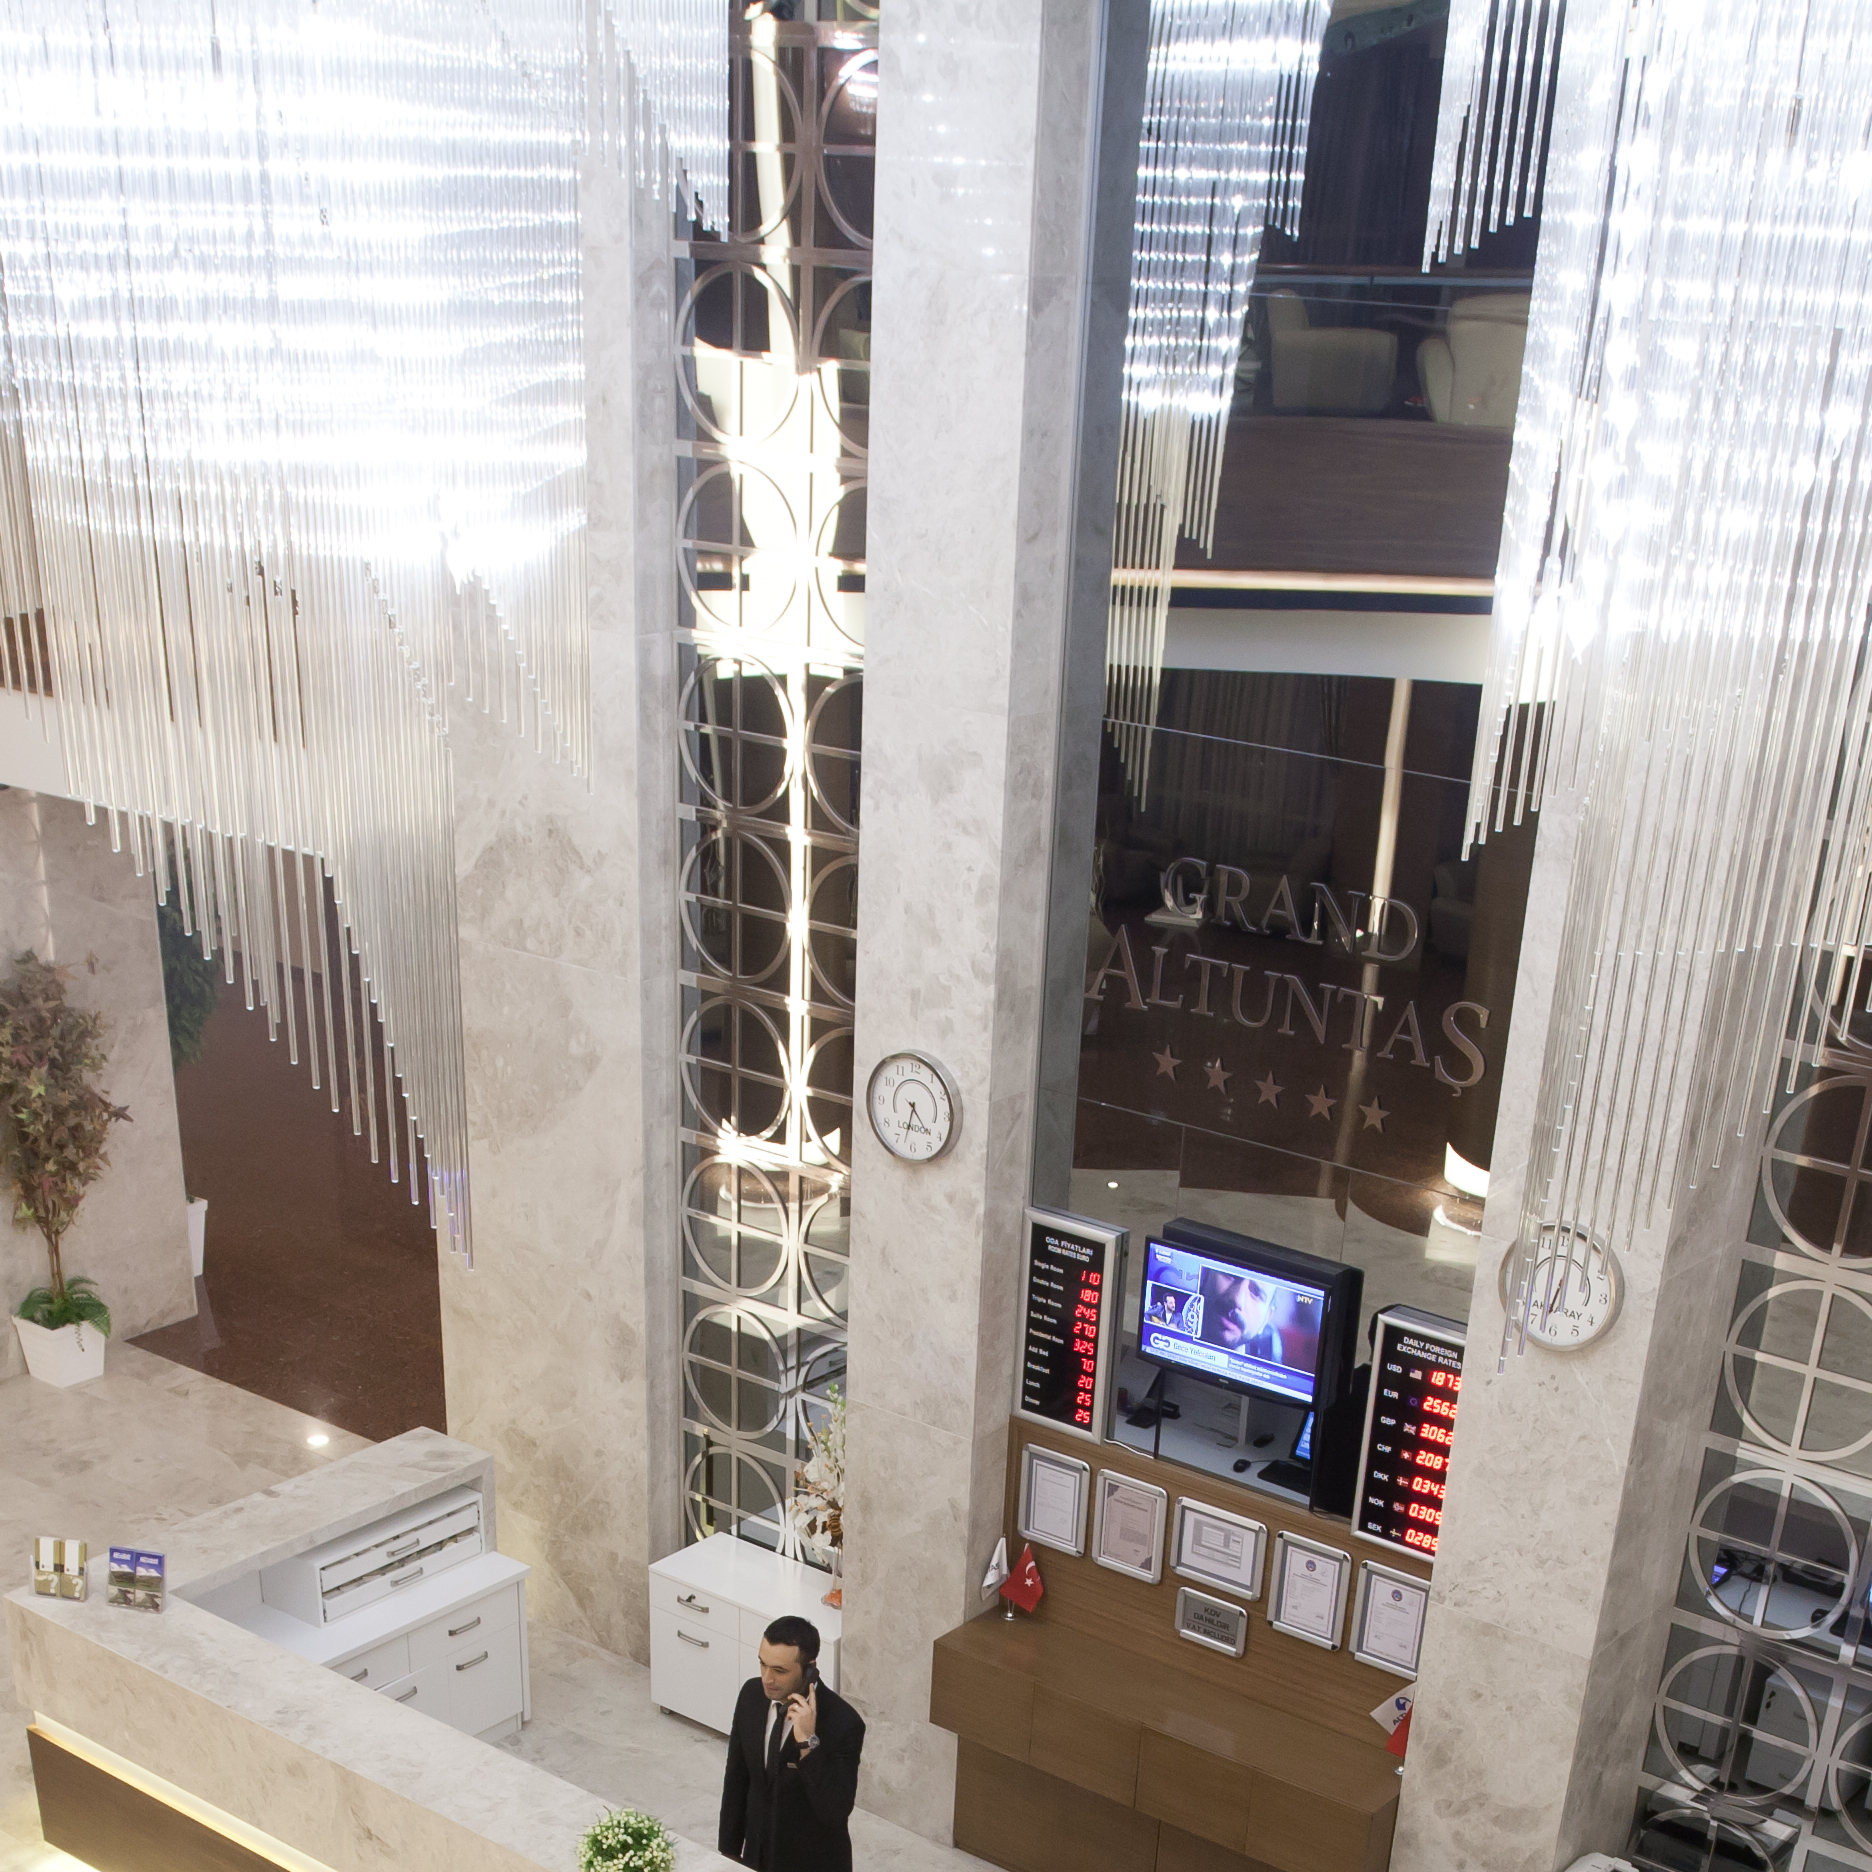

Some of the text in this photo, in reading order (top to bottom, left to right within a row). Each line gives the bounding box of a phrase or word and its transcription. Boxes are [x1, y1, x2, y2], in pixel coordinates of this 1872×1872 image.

[1160, 856, 1421, 963] GRAND
[1083, 923, 1493, 1098] ALTUNTAŞ
[896, 1064, 905, 1077] 11
[910, 1062, 921, 1075] 12
[884, 1076, 895, 1088] 10
[930, 1073, 934, 1084] 1
[878, 1095, 885, 1105] 9
[883, 1117, 891, 1129] 8
[897, 1120, 932, 1136] LONDON
[894, 1133, 901, 1144] 7
[936, 1131, 943, 1142] 4
[909, 1142, 917, 1154] 6
[926, 1141, 933, 1153] 5
[1081, 1270, 1101, 1286] 110
[1080, 1289, 1099, 1304] 180
[1297, 1295, 1313, 1305] NTV
[1599, 1293, 1608, 1305] 3
[1075, 1304, 1097, 1321] 245
[1530, 1313, 1537, 1325] 7
[1587, 1314, 1595, 1326] 4
[1073, 1321, 1097, 1338] 270
[1548, 1325, 1558, 1338] 6
[1570, 1325, 1580, 1337] 5
[1073, 1338, 1094, 1355] 325
[1403, 1336, 1458, 1360] DAILY FOREIGN
[1396, 1343, 1462, 1370] EXCHANGE RATES
[1387, 1362, 1403, 1374] USD
[1077, 1374, 1093, 1389] 20
[1077, 1392, 1091, 1406] 25
[1383, 1389, 1399, 1399] EUR
[1075, 1408, 1091, 1424] 25
[1380, 1416, 1396, 1426] GBP
[1373, 1471, 1389, 1482] DKK
[1368, 1496, 1384, 1507] NOK
[1368, 1522, 1382, 1533] SEK
[1204, 1607, 1221, 1618] KDV
[1203, 1628, 1236, 1645] INCLUDED
